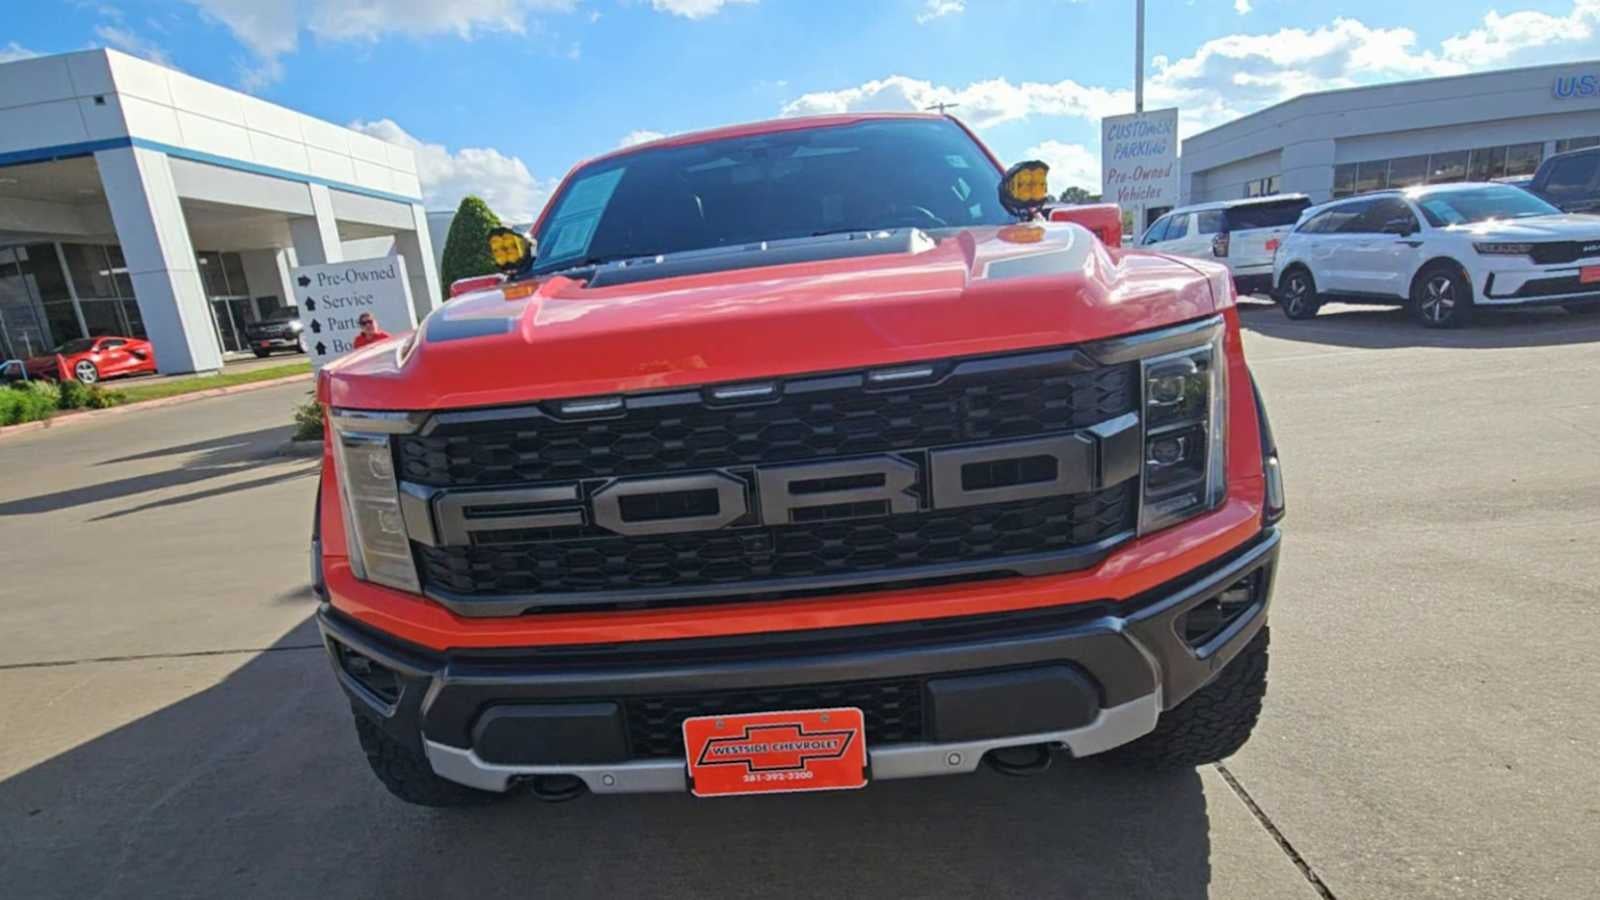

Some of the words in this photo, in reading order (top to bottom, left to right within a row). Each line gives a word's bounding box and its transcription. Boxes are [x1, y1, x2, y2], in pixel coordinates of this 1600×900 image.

[1113, 141, 1166, 160] PARKING
[1106, 162, 1173, 185] Pre-Owned
[1118, 184, 1162, 202] Vehicles
[318, 265, 395, 286] Pre-Owned
[322, 293, 373, 309] Service
[430, 432, 1098, 547] FORD
[713, 743, 768, 755] WESTSIDE
[772, 740, 838, 752] CHEVROLET
